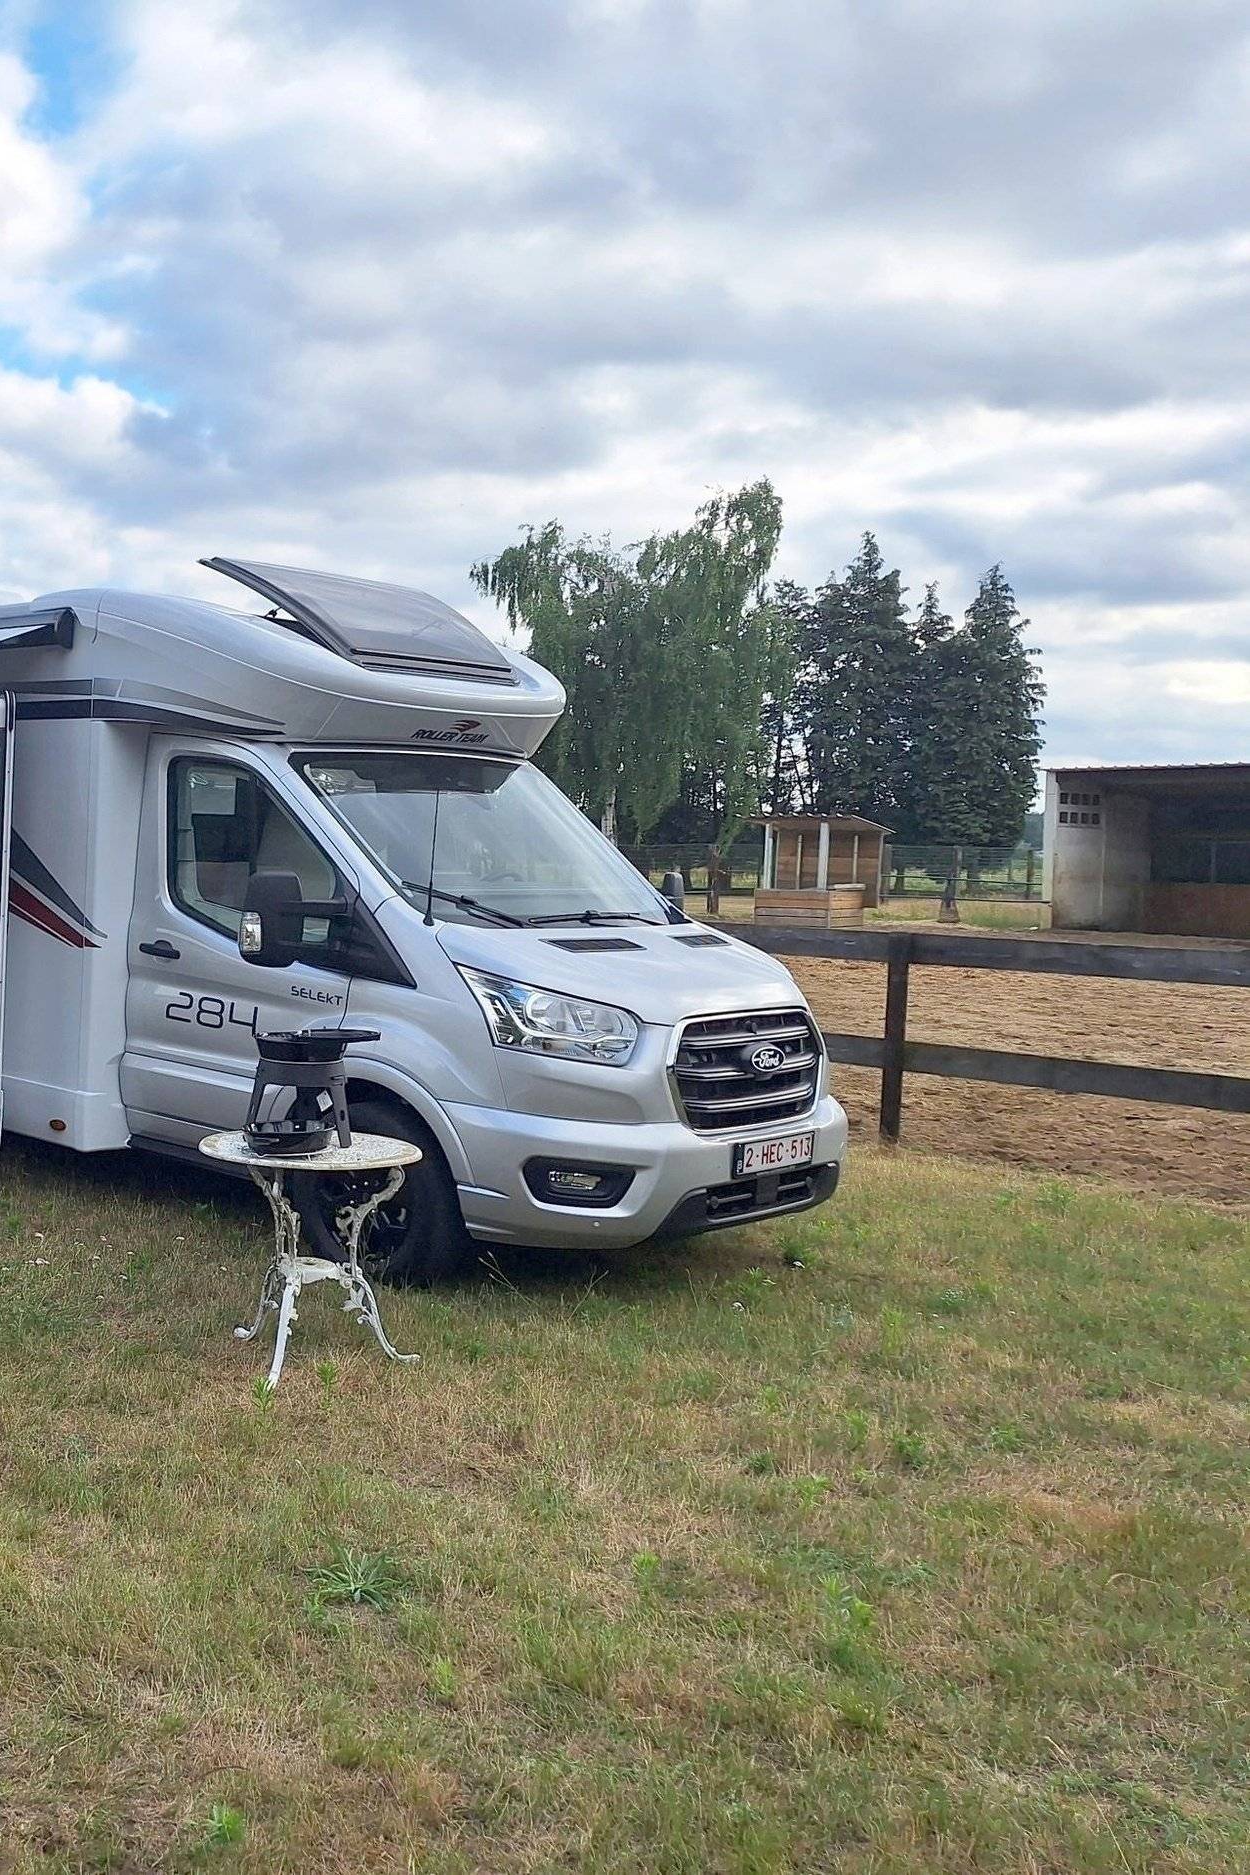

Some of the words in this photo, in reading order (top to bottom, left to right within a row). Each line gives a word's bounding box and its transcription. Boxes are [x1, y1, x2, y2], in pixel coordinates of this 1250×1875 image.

[410, 729, 459, 742] ROLLER
[455, 733, 490, 743] TEAM
[291, 985, 343, 1006] SELEKT
[165, 991, 259, 1036] 284
[753, 1050, 780, 1068] Ford
